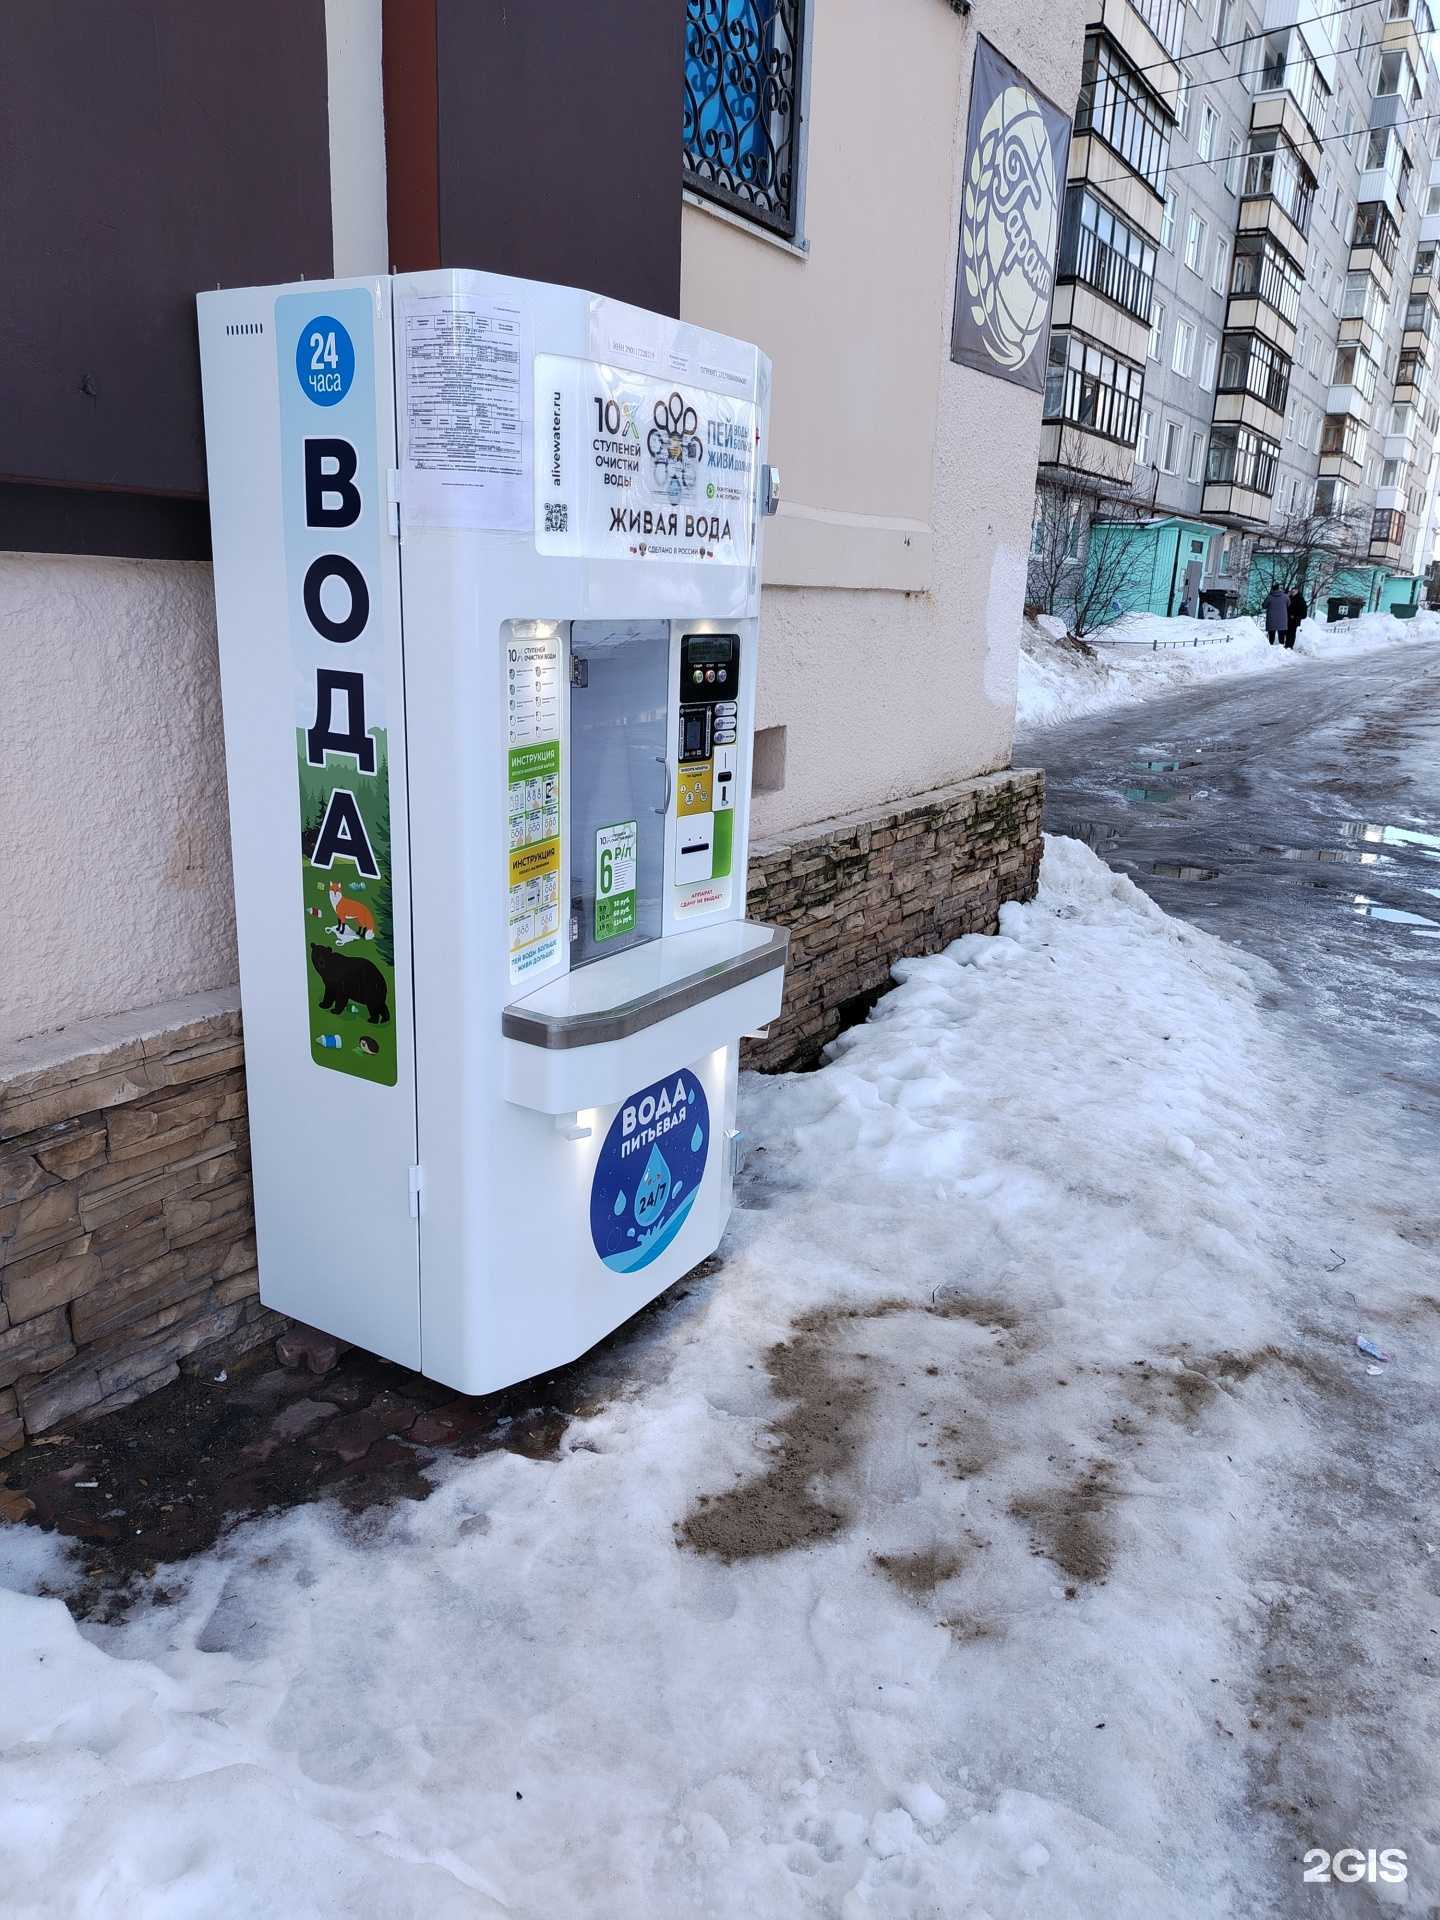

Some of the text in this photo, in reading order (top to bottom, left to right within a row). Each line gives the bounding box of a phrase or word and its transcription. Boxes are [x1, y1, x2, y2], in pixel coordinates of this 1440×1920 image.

[309, 332, 339, 370] 24
[309, 372, 342, 393] часа
[551, 391, 561, 487] alivewater.ru
[593, 439, 641, 457] СТУПЕНЕЙ
[707, 417, 733, 449] ПЕЙ
[595, 455, 639, 472] ОЧИСТКИ
[707, 450, 734, 470] ЖИВИ
[604, 473, 632, 488] ВОДЫ
[609, 507, 731, 542] ЖИВАЯ ВОДА
[303, 438, 379, 878] ВОДА
[511, 750, 555, 768] ИНСТРУКЦИЯ
[512, 847, 555, 870] ИНСТРУКЦИЯ
[600, 848, 613, 894] 6
[622, 1077, 687, 1137] ВОДА
[621, 1106, 687, 1159] ПИТЬЕВАЯ
[639, 1182, 667, 1215] 24/7
